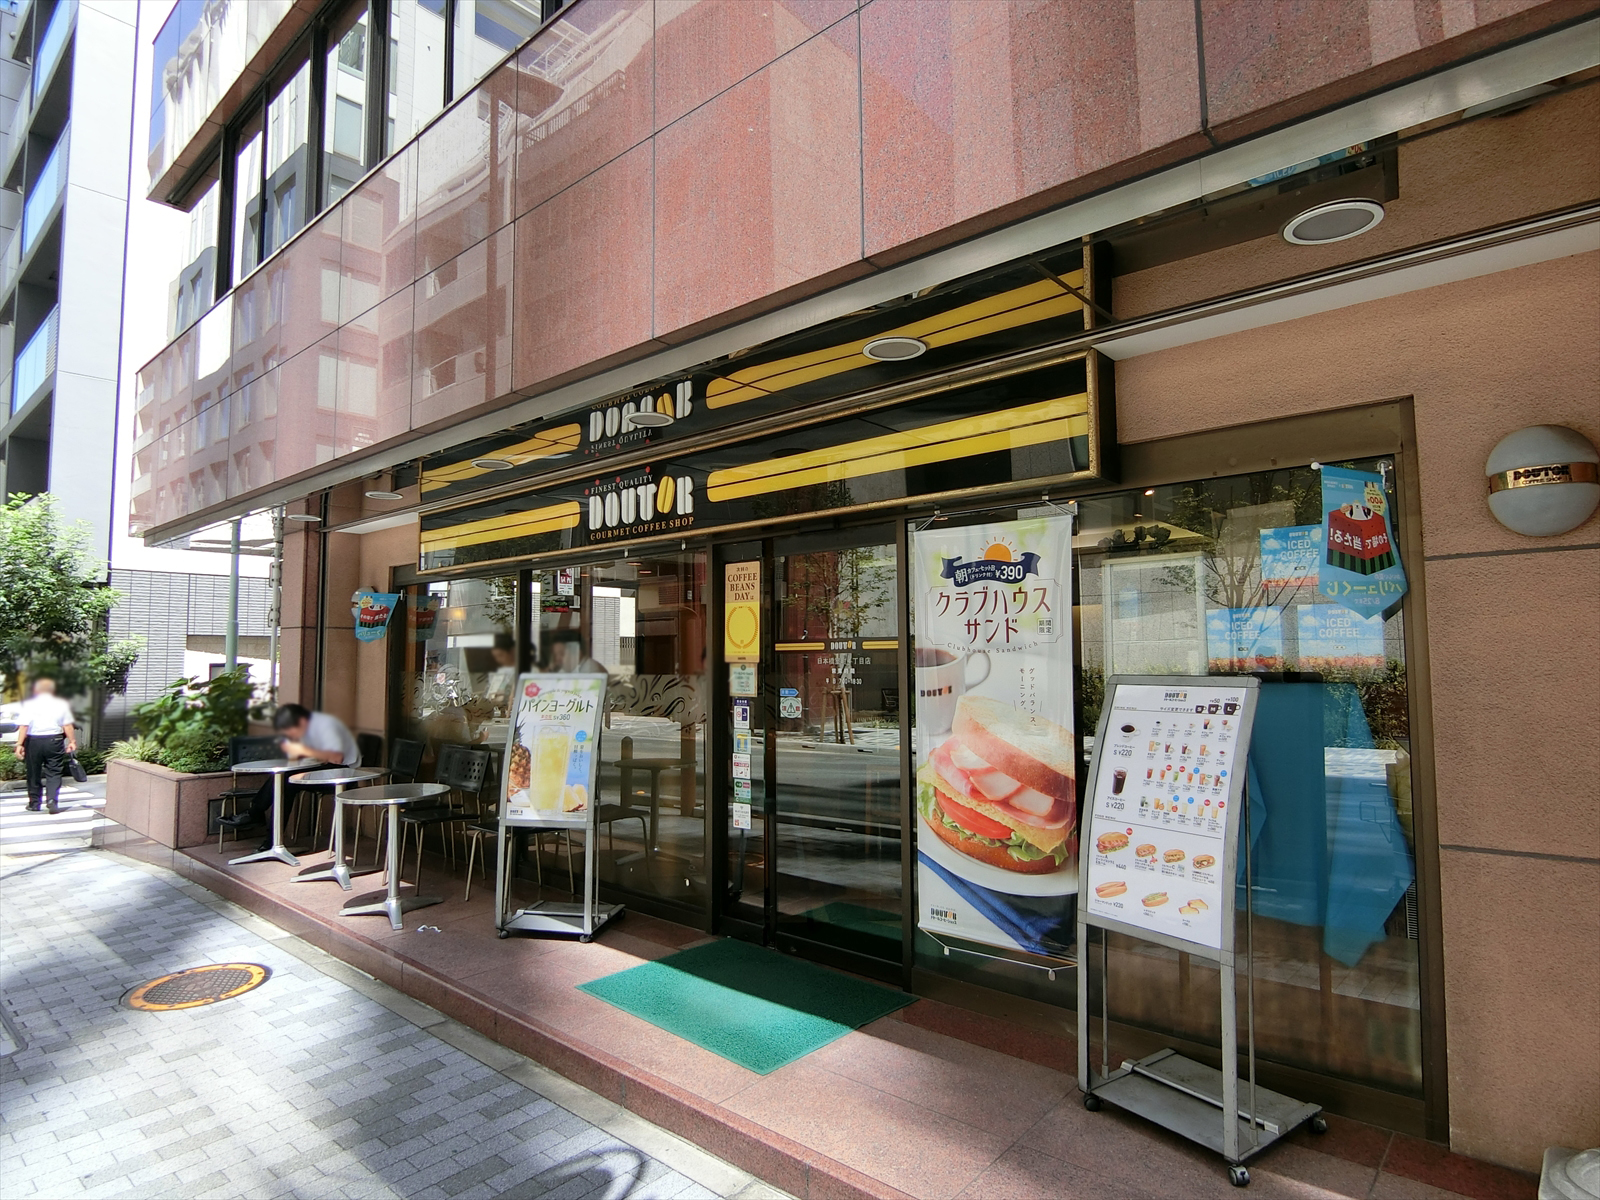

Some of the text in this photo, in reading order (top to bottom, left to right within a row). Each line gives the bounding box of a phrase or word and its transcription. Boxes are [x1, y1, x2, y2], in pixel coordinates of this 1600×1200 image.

[1513, 465, 1570, 481] DOUTOR
[590, 474, 654, 495] FINEST QUALITY
[588, 475, 694, 531] DOUTOR
[590, 516, 695, 541] GOURMET COFFEE SHOP
[1287, 539, 1311, 550] ICED
[1280, 548, 1320, 560] COFFEE
[727, 572, 758, 583] COFFEE
[954, 568, 969, 584] 朝
[995, 565, 1023, 580] ¥390
[730, 582, 756, 592] BEANS
[935, 586, 1051, 618] クラブハウス
[1231, 621, 1253, 631] ICED
[1326, 617, 1351, 627] ICED
[964, 617, 1019, 645] サンド
[1224, 630, 1261, 640] COFFEE
[1318, 627, 1360, 638] COFFEE
[830, 640, 857, 650] DOUTOR
[947, 641, 1039, 654] Clubhouse Sandwich
[521, 698, 594, 713] パインヨーグルト
[1118, 749, 1133, 757] ¥220
[1111, 802, 1125, 810] ¥220
[930, 908, 957, 920] DOUTOR
